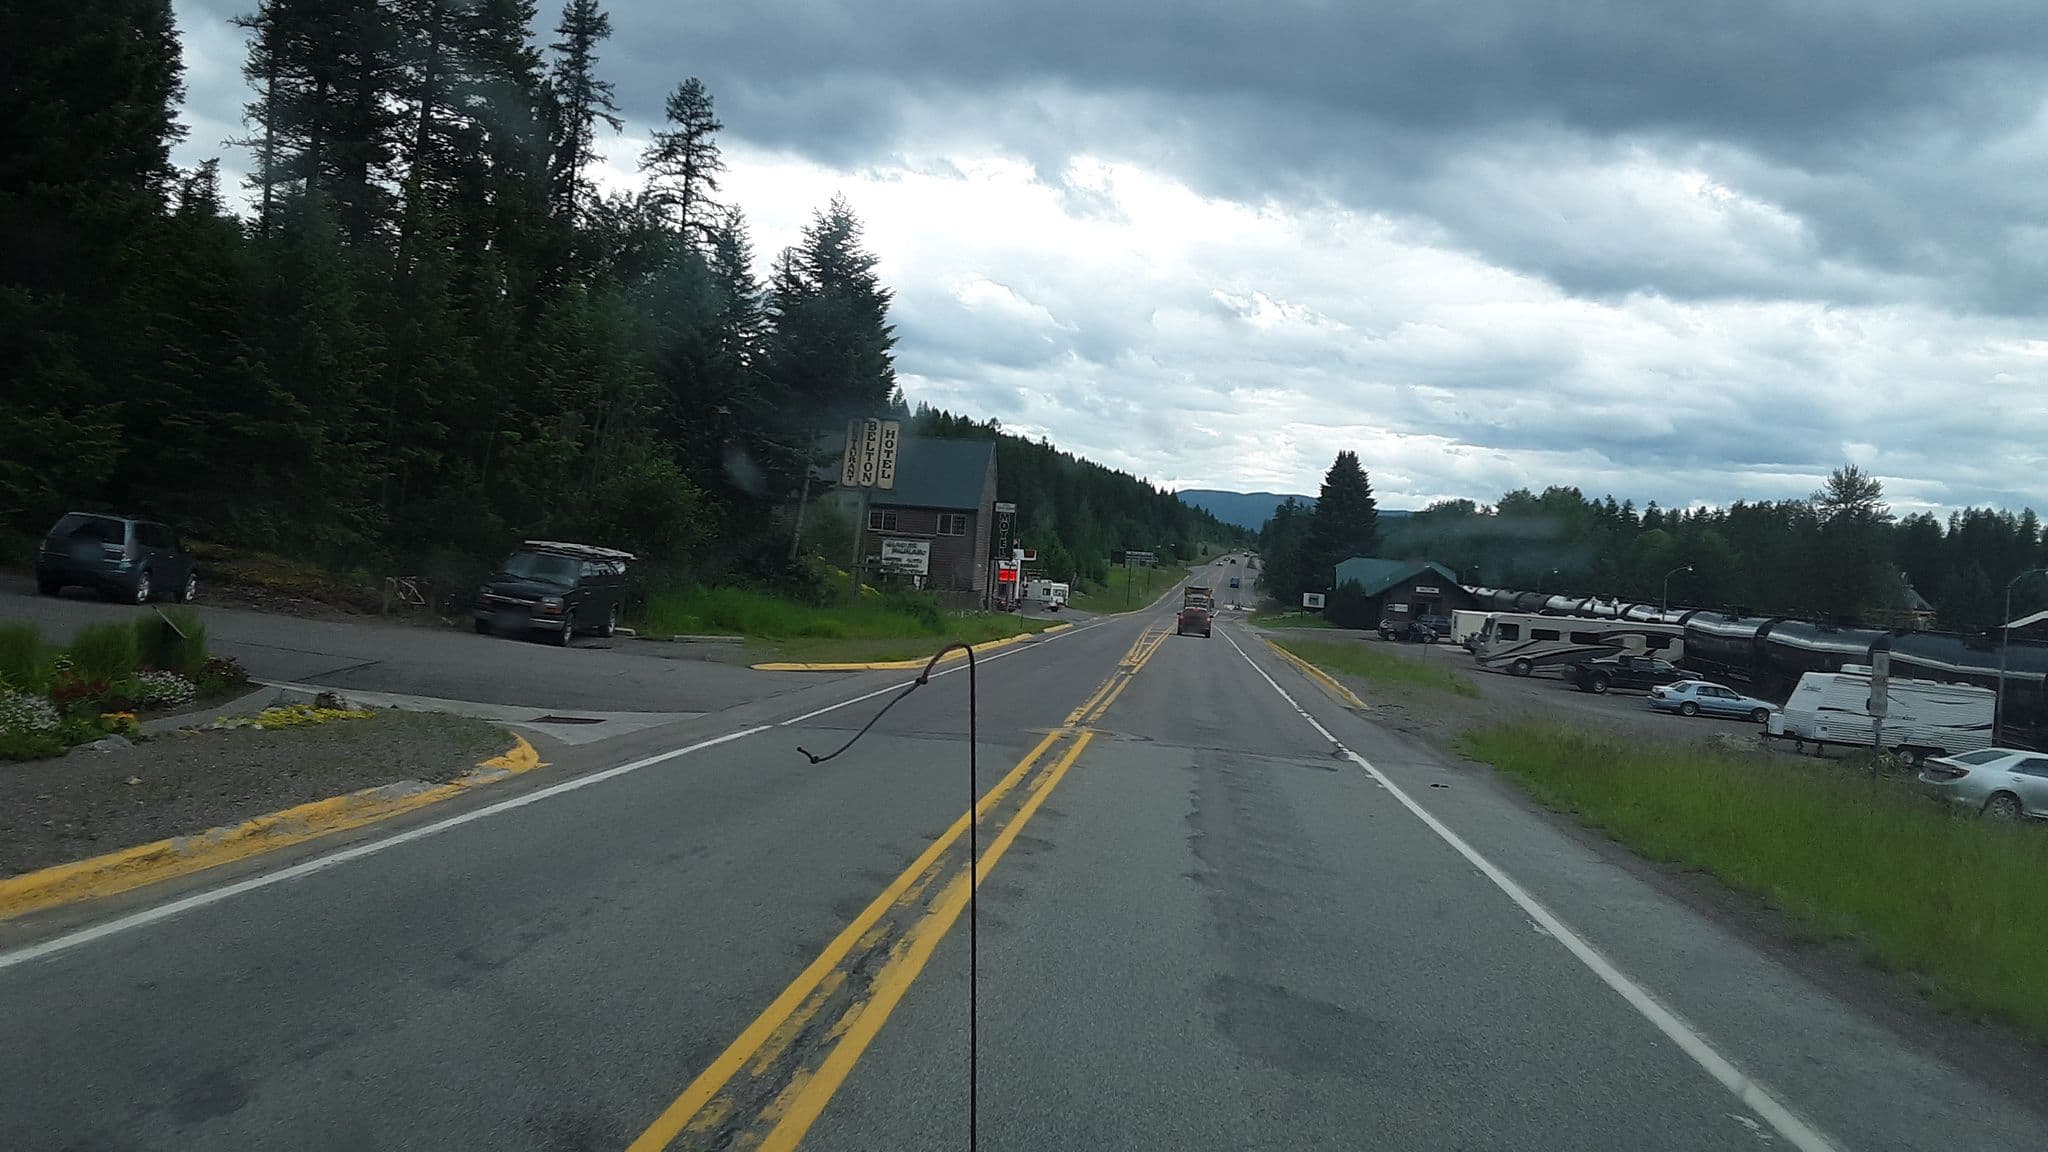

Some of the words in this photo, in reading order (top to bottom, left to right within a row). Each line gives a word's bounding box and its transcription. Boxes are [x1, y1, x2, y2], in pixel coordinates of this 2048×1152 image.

[862, 421, 877, 482] BELTON
[881, 429, 896, 479] HOTEL
[999, 511, 1011, 557] MOTEL
